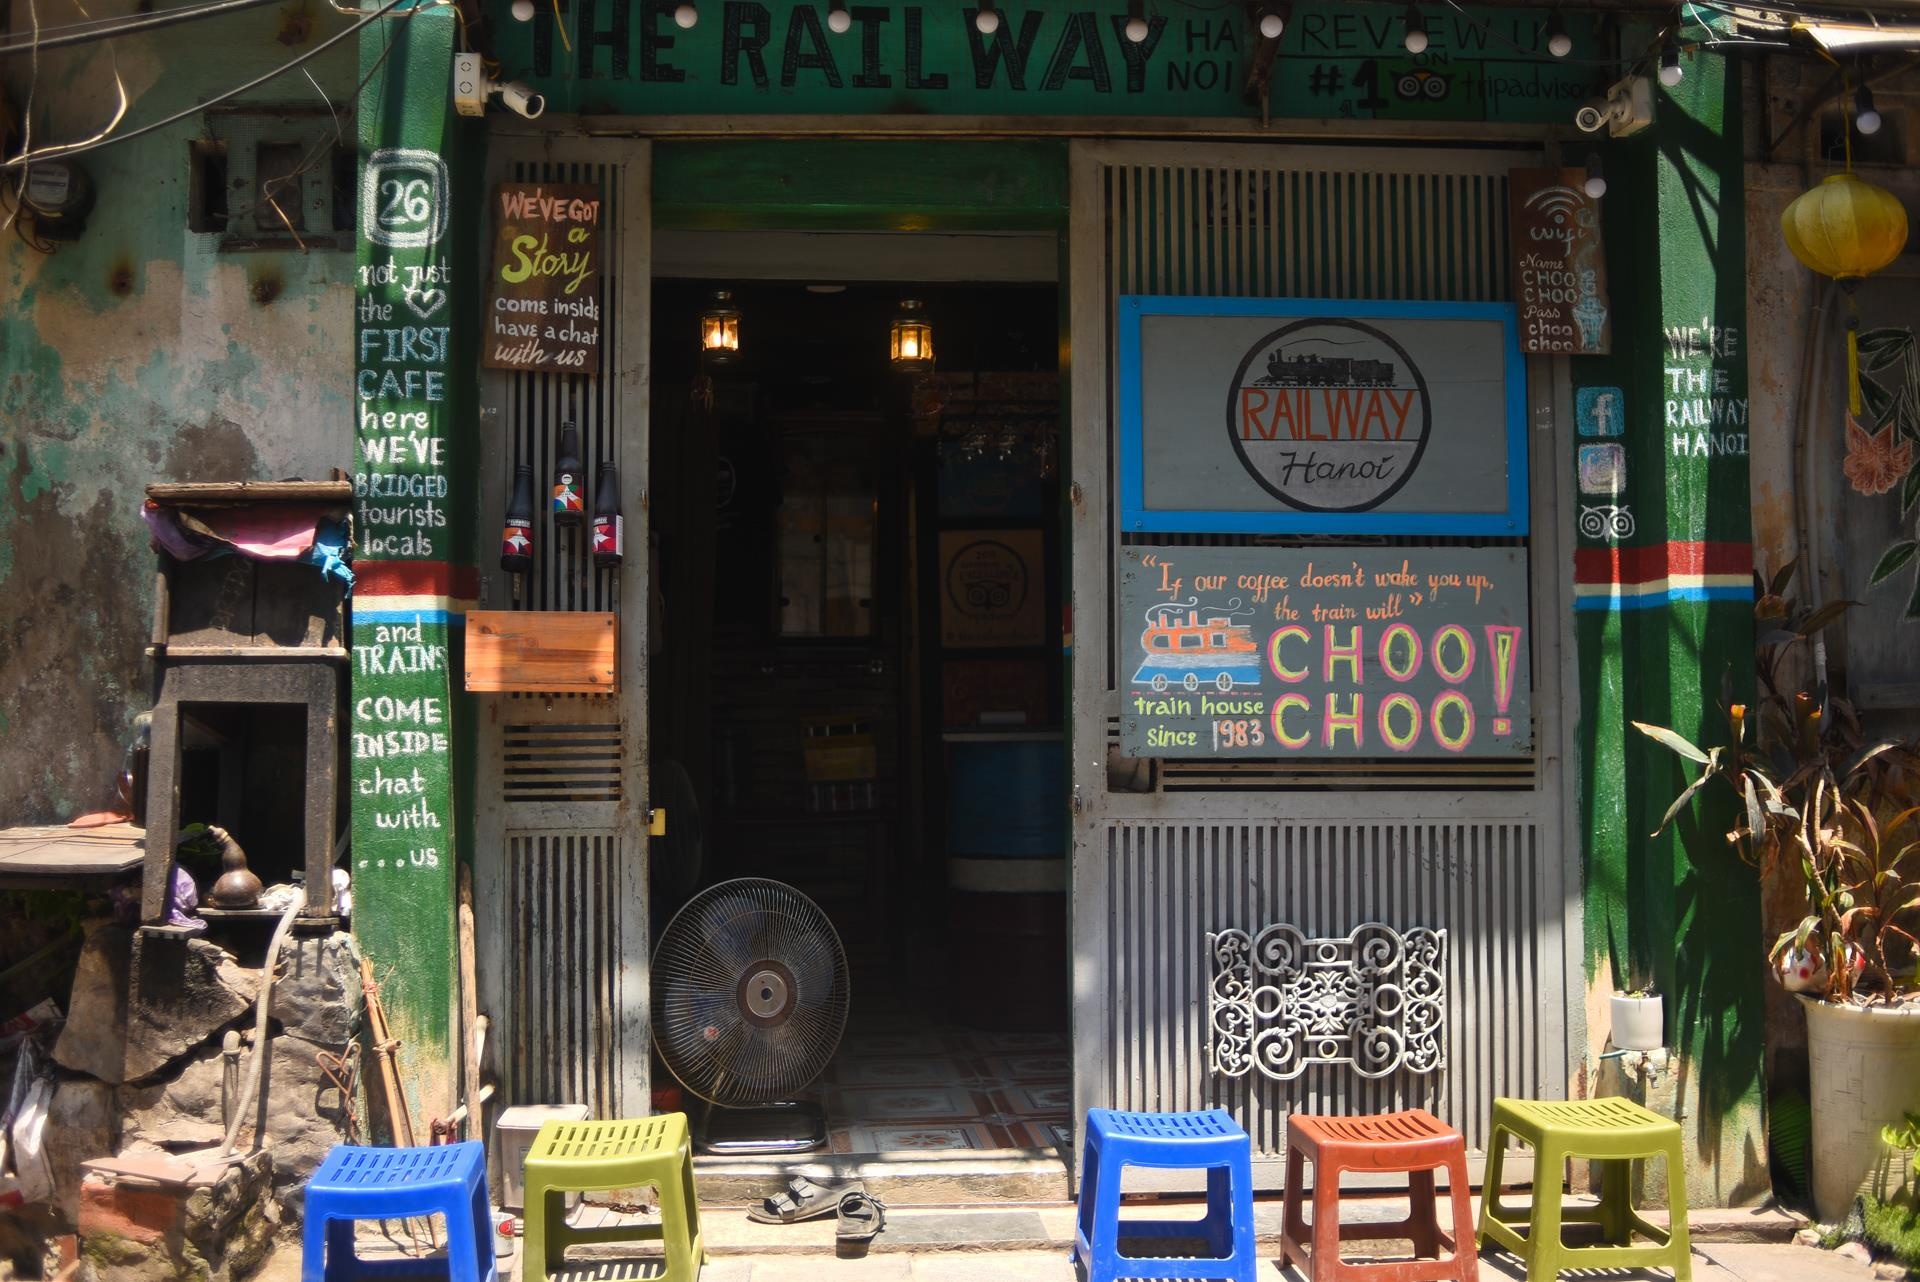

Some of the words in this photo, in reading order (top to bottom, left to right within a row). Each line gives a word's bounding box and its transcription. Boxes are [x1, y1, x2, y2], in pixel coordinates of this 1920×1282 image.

[524, 0, 687, 82] THE
[721, 2, 1168, 92] RAILWAY
[1186, 18, 1238, 52] HA
[1413, 52, 1448, 67] ON
[1167, 60, 1233, 93] NOI
[1461, 65, 1593, 115] tripadvisor
[379, 180, 431, 224] 26
[501, 187, 566, 222] WE'VE
[567, 199, 600, 226] GOT
[568, 227, 590, 243] a
[1530, 227, 1587, 257] wifi
[359, 255, 398, 286] not
[402, 256, 450, 292] just
[501, 233, 594, 294] Story
[1520, 253, 1563, 269] Name
[1522, 270, 1576, 287] CHOO
[358, 293, 392, 323] the
[495, 296, 548, 314] come
[554, 296, 599, 321] inside
[1524, 287, 1577, 303] CHOO
[1523, 305, 1561, 320] Pass
[1528, 318, 1573, 336] choo
[360, 326, 450, 362] FIRST
[495, 316, 538, 339] have
[544, 326, 556, 340] a
[559, 320, 599, 346] chat
[1664, 316, 1738, 360] WE'RE
[494, 338, 548, 366] with
[556, 348, 587, 367] us
[357, 369, 445, 401] CAFE
[1664, 367, 1729, 393] THE
[360, 402, 430, 430] here
[1242, 389, 1415, 441] RAILWAY
[1665, 397, 1748, 427] RAILWAY
[359, 431, 446, 465] WE'VE
[1672, 432, 1748, 457] HANOI
[1280, 451, 1395, 486] Hanoi
[355, 473, 448, 498] BRIDGED
[358, 500, 446, 527] tourists
[364, 529, 433, 556] locals
[1195, 573, 1228, 593] our
[1237, 570, 1290, 603] coffee
[1300, 561, 1366, 588] doesn't
[1375, 560, 1418, 587] wake
[1428, 571, 1462, 601] you
[1274, 597, 1300, 621] the
[1312, 598, 1357, 623] train
[376, 613, 425, 643] and
[353, 645, 448, 675] TRAINS
[356, 696, 441, 725] COME
[1134, 696, 1192, 717] train
[1200, 695, 1265, 716] house
[1270, 690, 1476, 752] CHOO
[353, 731, 448, 758] INSIDE
[1147, 724, 1198, 748] since
[1212, 717, 1265, 752] 1983
[359, 766, 426, 795] chat
[376, 797, 441, 829] with
